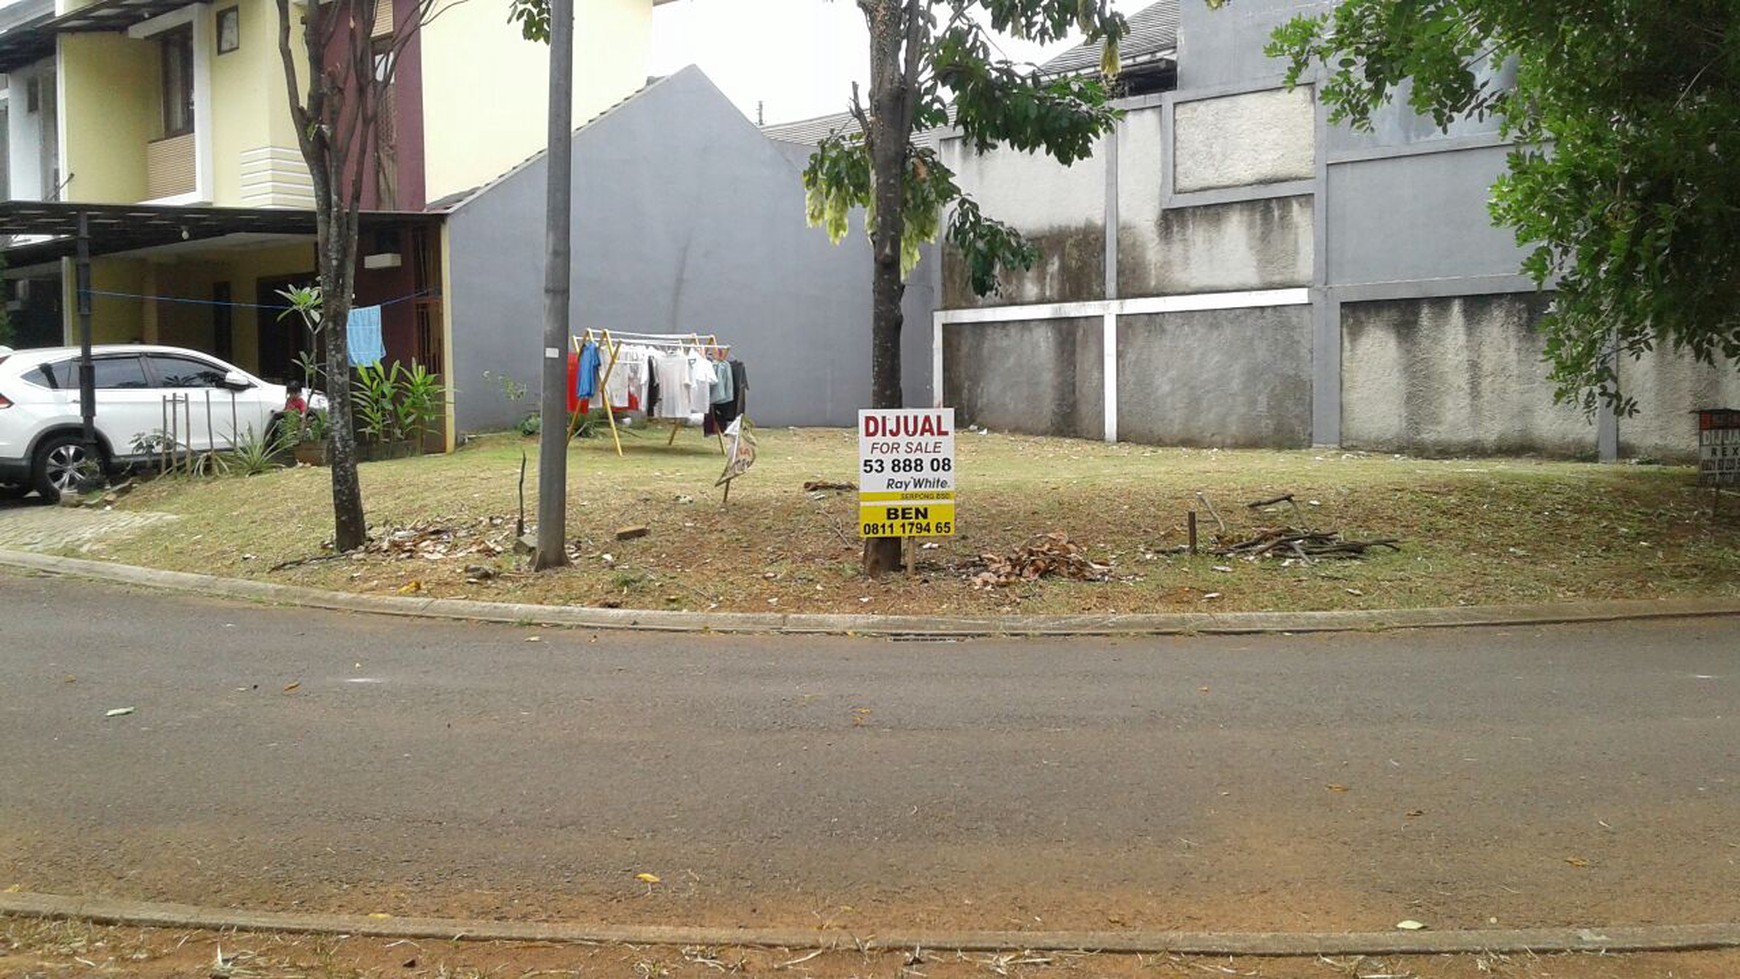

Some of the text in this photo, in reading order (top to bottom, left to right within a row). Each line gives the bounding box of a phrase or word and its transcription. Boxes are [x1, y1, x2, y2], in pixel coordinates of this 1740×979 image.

[864, 415, 949, 437] DIJUAL
[870, 442, 942, 454] FOR SALE
[863, 458, 952, 473] 53 888 08
[886, 478, 910, 490] Ray
[886, 507, 928, 520] BEN
[864, 522, 951, 535] 0811 1794 65
